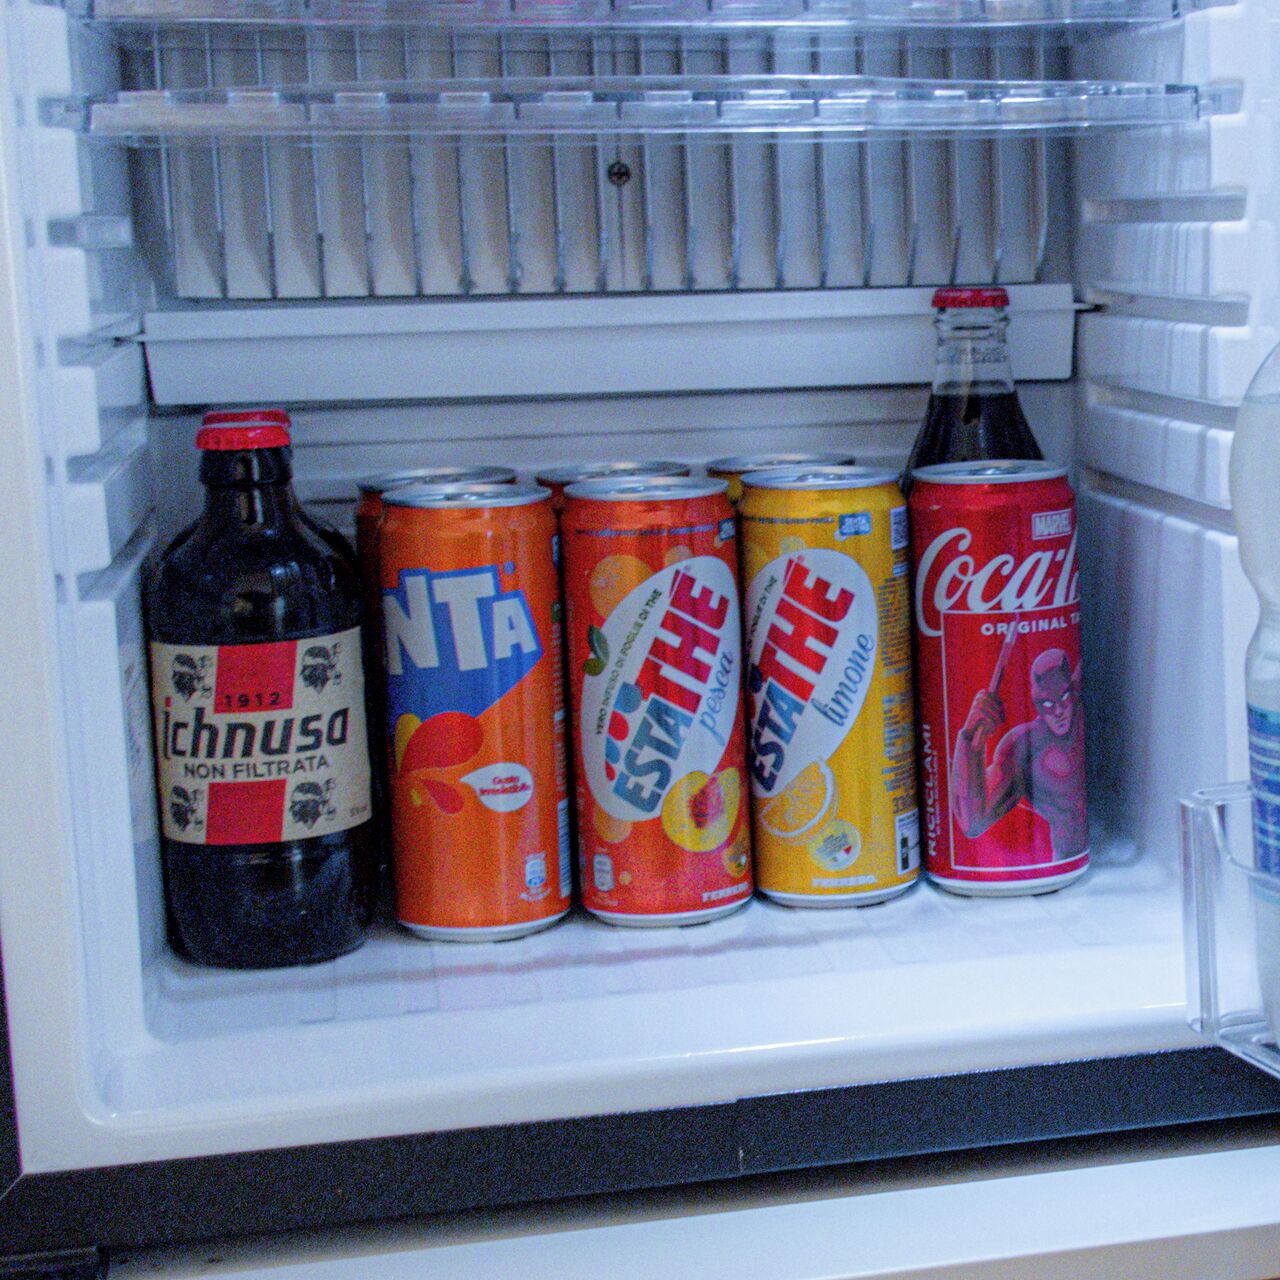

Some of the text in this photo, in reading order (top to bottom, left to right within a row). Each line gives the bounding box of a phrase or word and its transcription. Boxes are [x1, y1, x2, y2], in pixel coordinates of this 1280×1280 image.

[638, 608, 651, 622] DI
[223, 691, 281, 708] 1912
[699, 649, 736, 750] pesca
[813, 631, 875, 728] limone
[162, 696, 350, 760] ichnusa
[184, 755, 330, 779] NON FILTRATA
